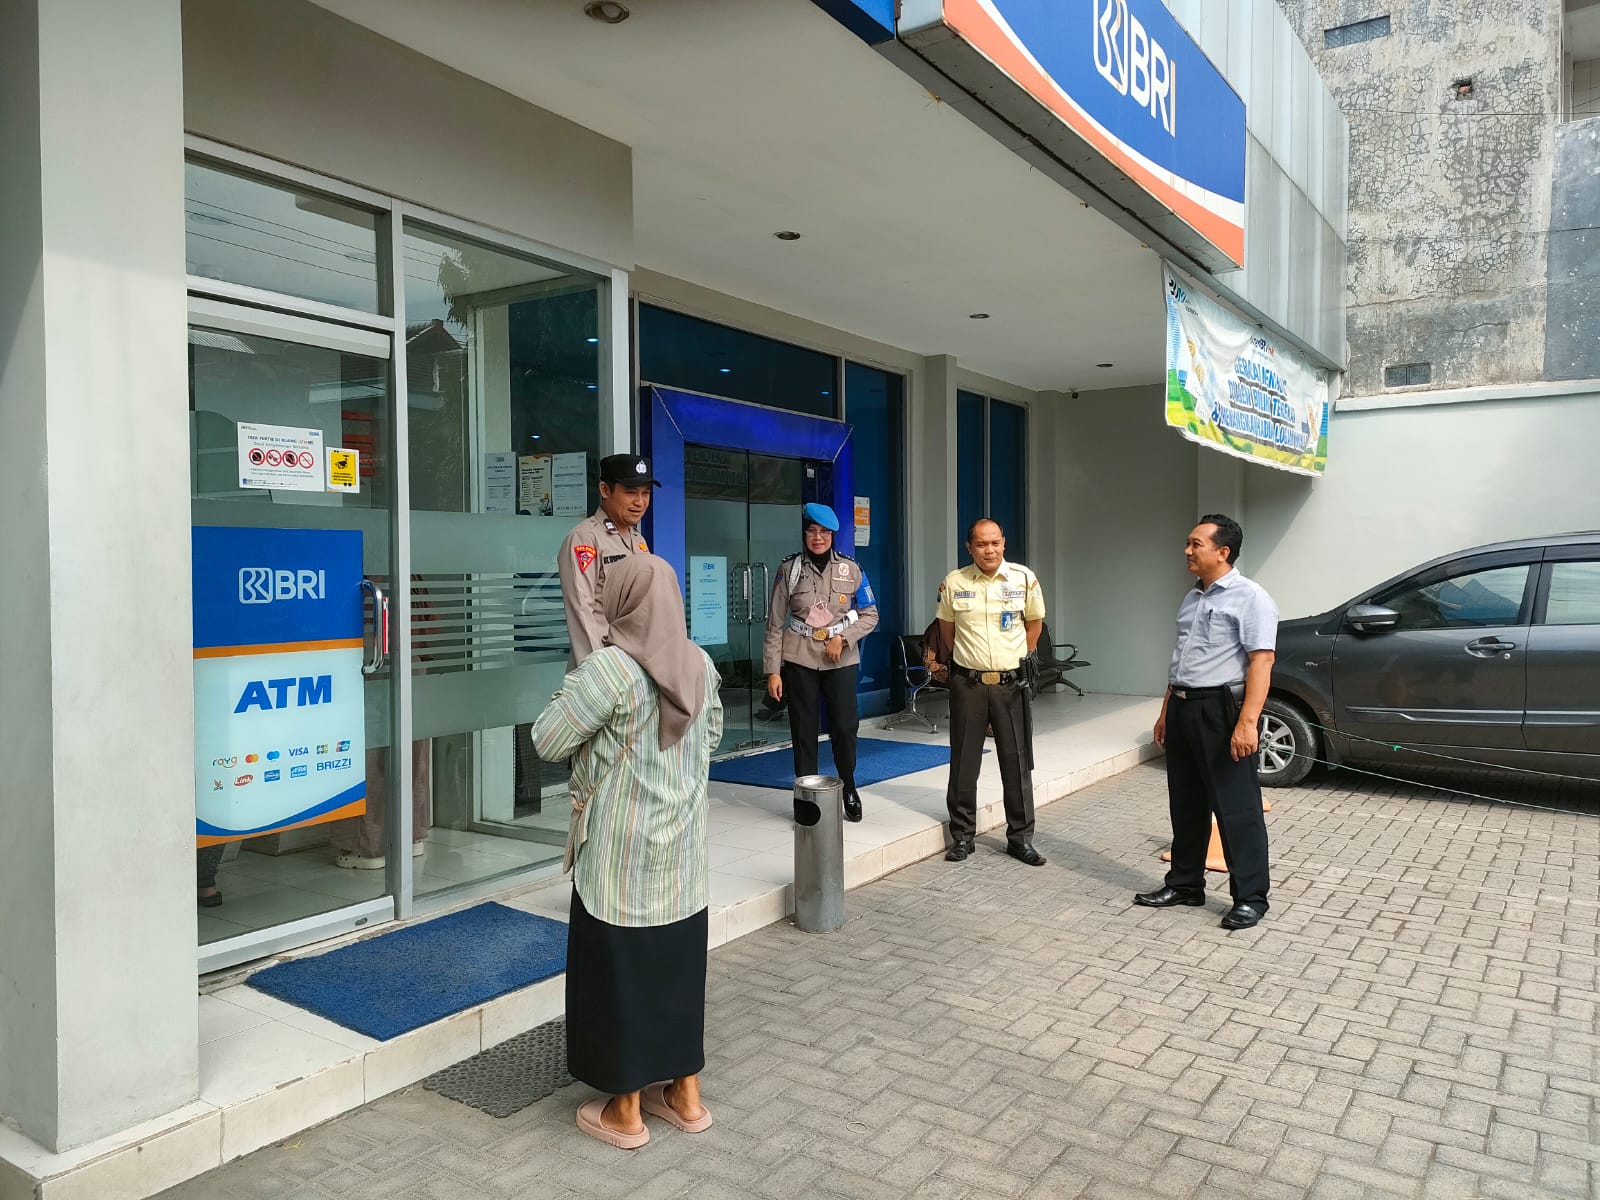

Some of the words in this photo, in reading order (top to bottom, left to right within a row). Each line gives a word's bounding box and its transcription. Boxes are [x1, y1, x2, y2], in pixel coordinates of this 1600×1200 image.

[1130, 13, 1176, 138] BRI
[275, 569, 326, 600] BRI
[234, 675, 332, 714] ATM
[288, 747, 310, 757] VISA
[234, 775, 253, 785] Link
[316, 758, 352, 771] BRIZZI
